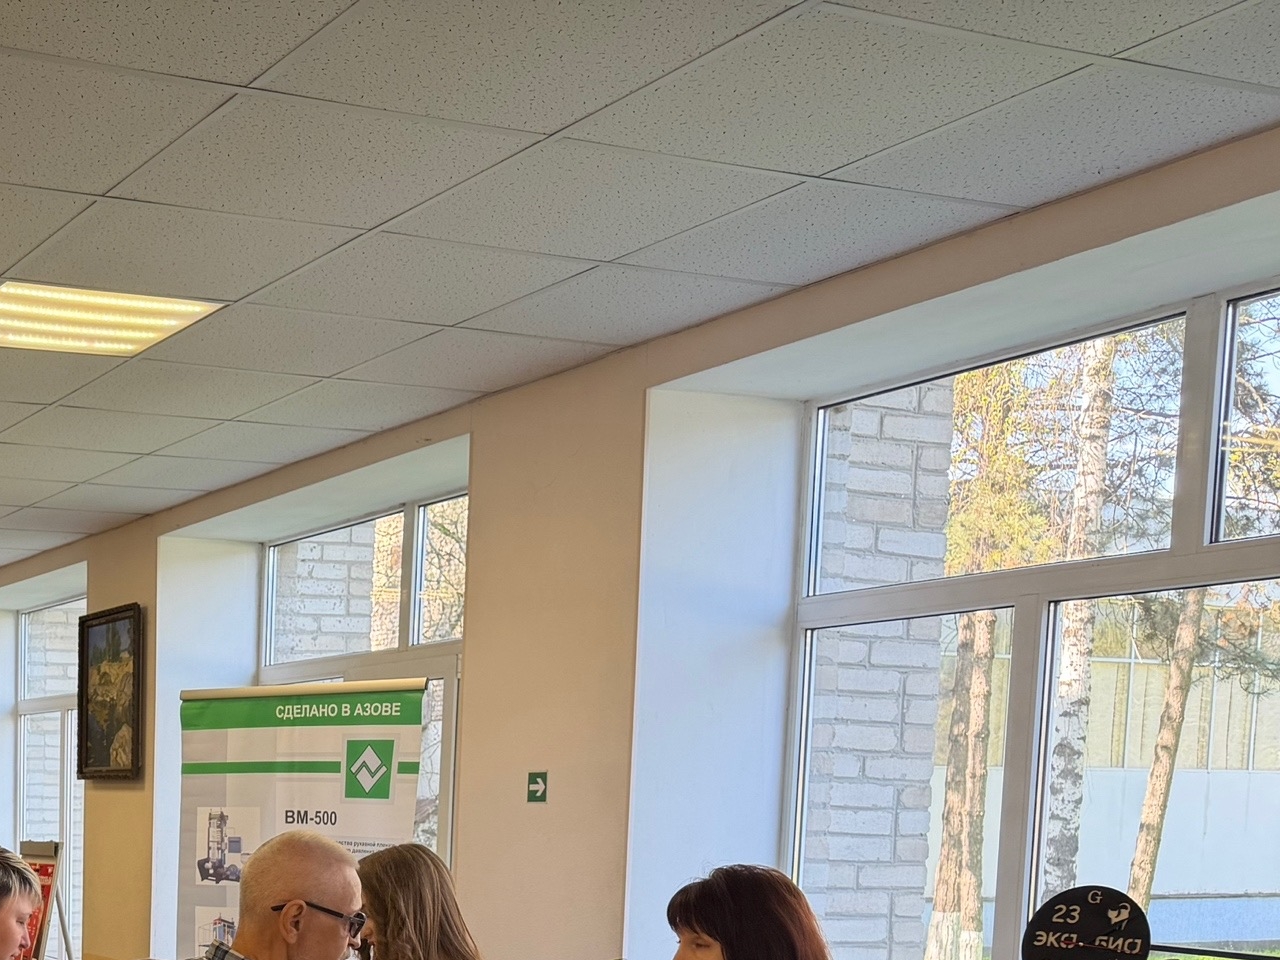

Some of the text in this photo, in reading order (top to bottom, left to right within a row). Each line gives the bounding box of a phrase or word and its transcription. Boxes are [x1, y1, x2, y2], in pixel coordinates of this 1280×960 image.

[275, 702, 402, 720] СДЕЛАНО В АЗОВЕ
[284, 809, 338, 826] ВМ-500
[1087, 890, 1103, 904] G
[1051, 904, 1081, 924] 23
[1032, 930, 1143, 955] ЭКО БИО
